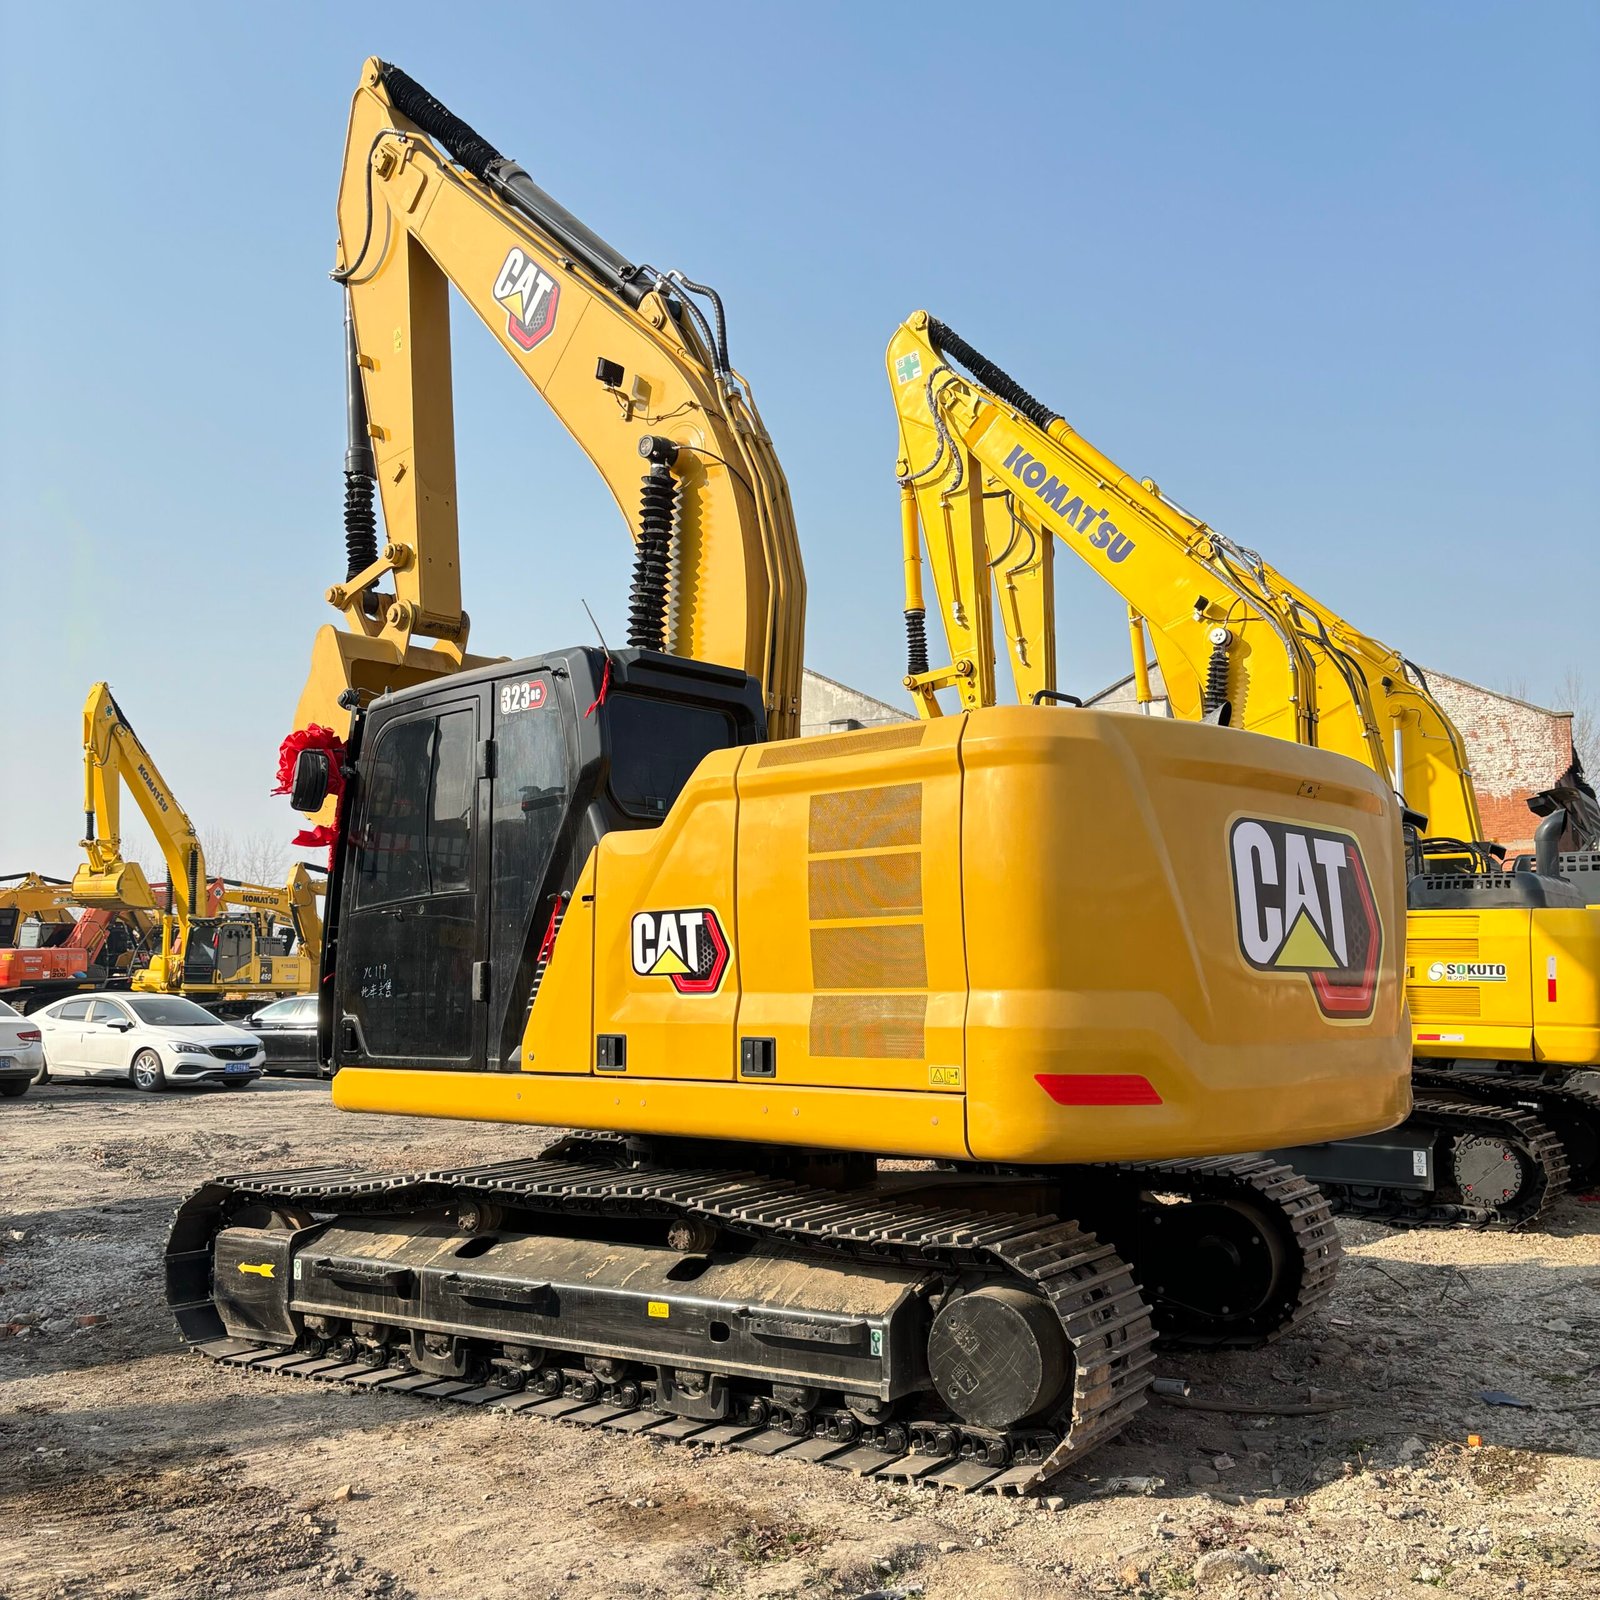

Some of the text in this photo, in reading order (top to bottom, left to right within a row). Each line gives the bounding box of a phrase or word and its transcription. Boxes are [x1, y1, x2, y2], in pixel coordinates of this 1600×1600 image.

[494, 248, 554, 327] CAT
[1003, 444, 1136, 563] KOMATSU
[501, 682, 530, 713] 323
[138, 764, 168, 812] KOMATSU
[242, 895, 279, 905] KOMATSU
[1233, 821, 1349, 968] CAT
[633, 912, 703, 974] CAT
[260, 973, 272, 981] 450
[1446, 964, 1506, 975] SOKUTO
